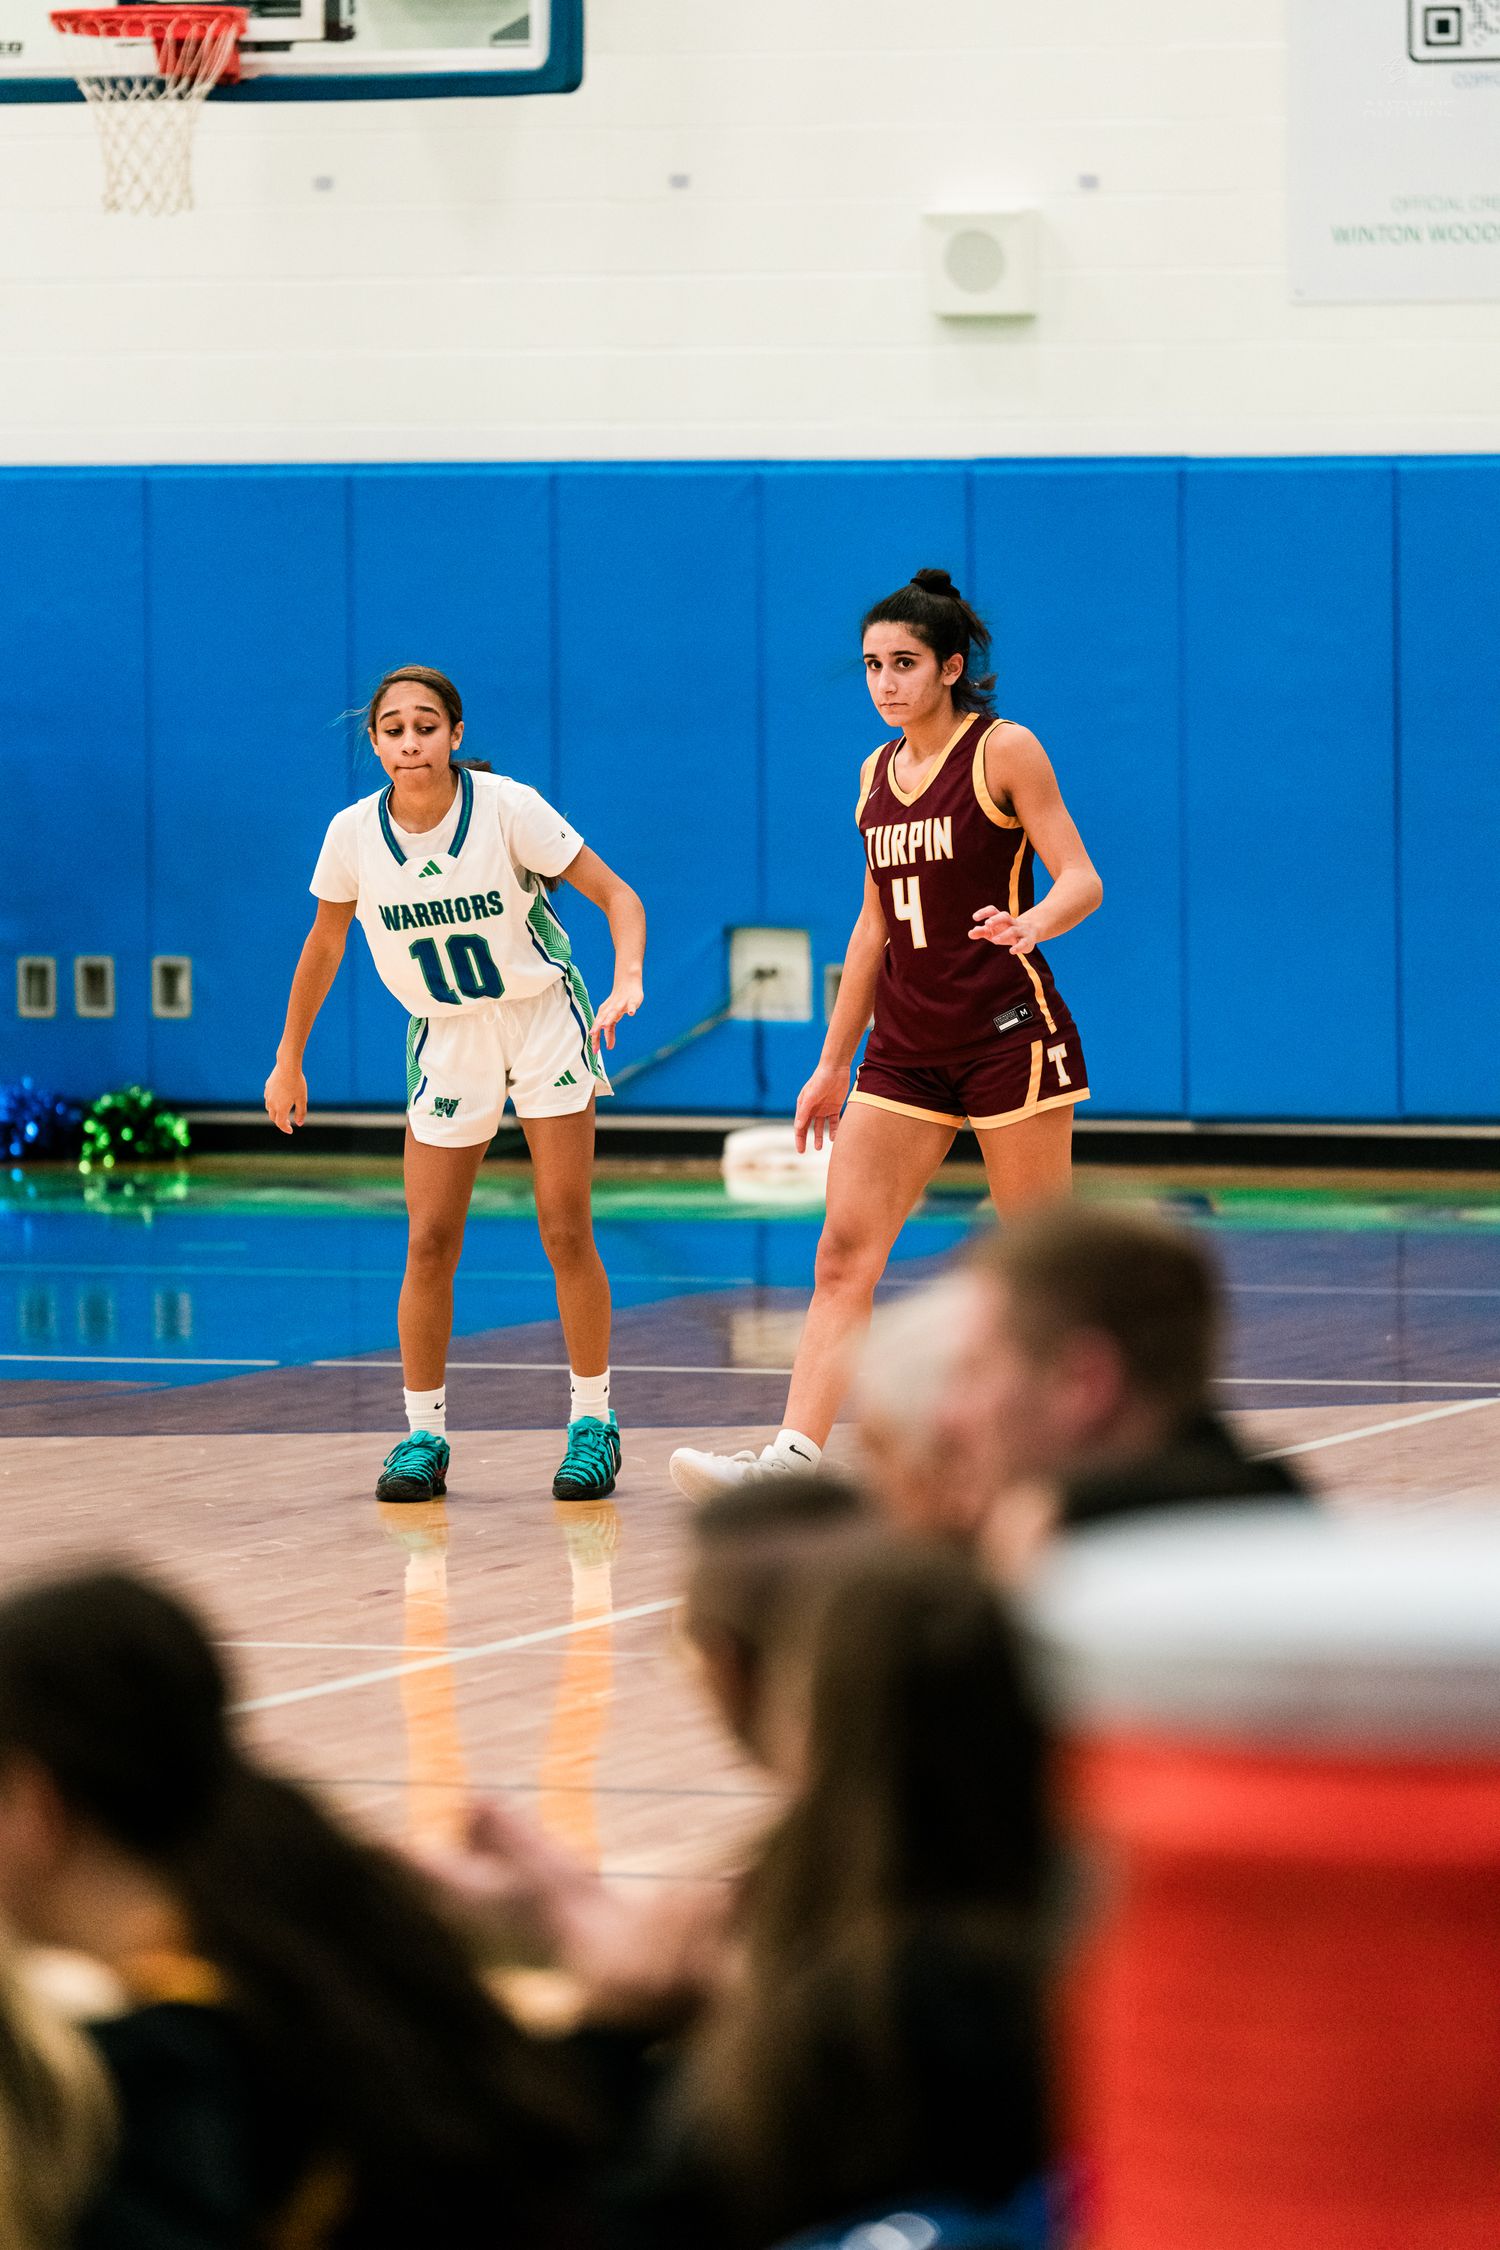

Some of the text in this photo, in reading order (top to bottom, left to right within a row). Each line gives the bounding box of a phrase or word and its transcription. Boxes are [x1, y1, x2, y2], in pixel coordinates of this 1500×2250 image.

[1330, 222, 1500, 245] WINTON WOOD
[865, 815, 954, 871] TURPIN
[378, 890, 504, 932] WARRIORS
[891, 875, 928, 950] 4
[408, 933, 505, 1006] 10
[1019, 1008, 1029, 1017] M
[1046, 1042, 1072, 1088] T
